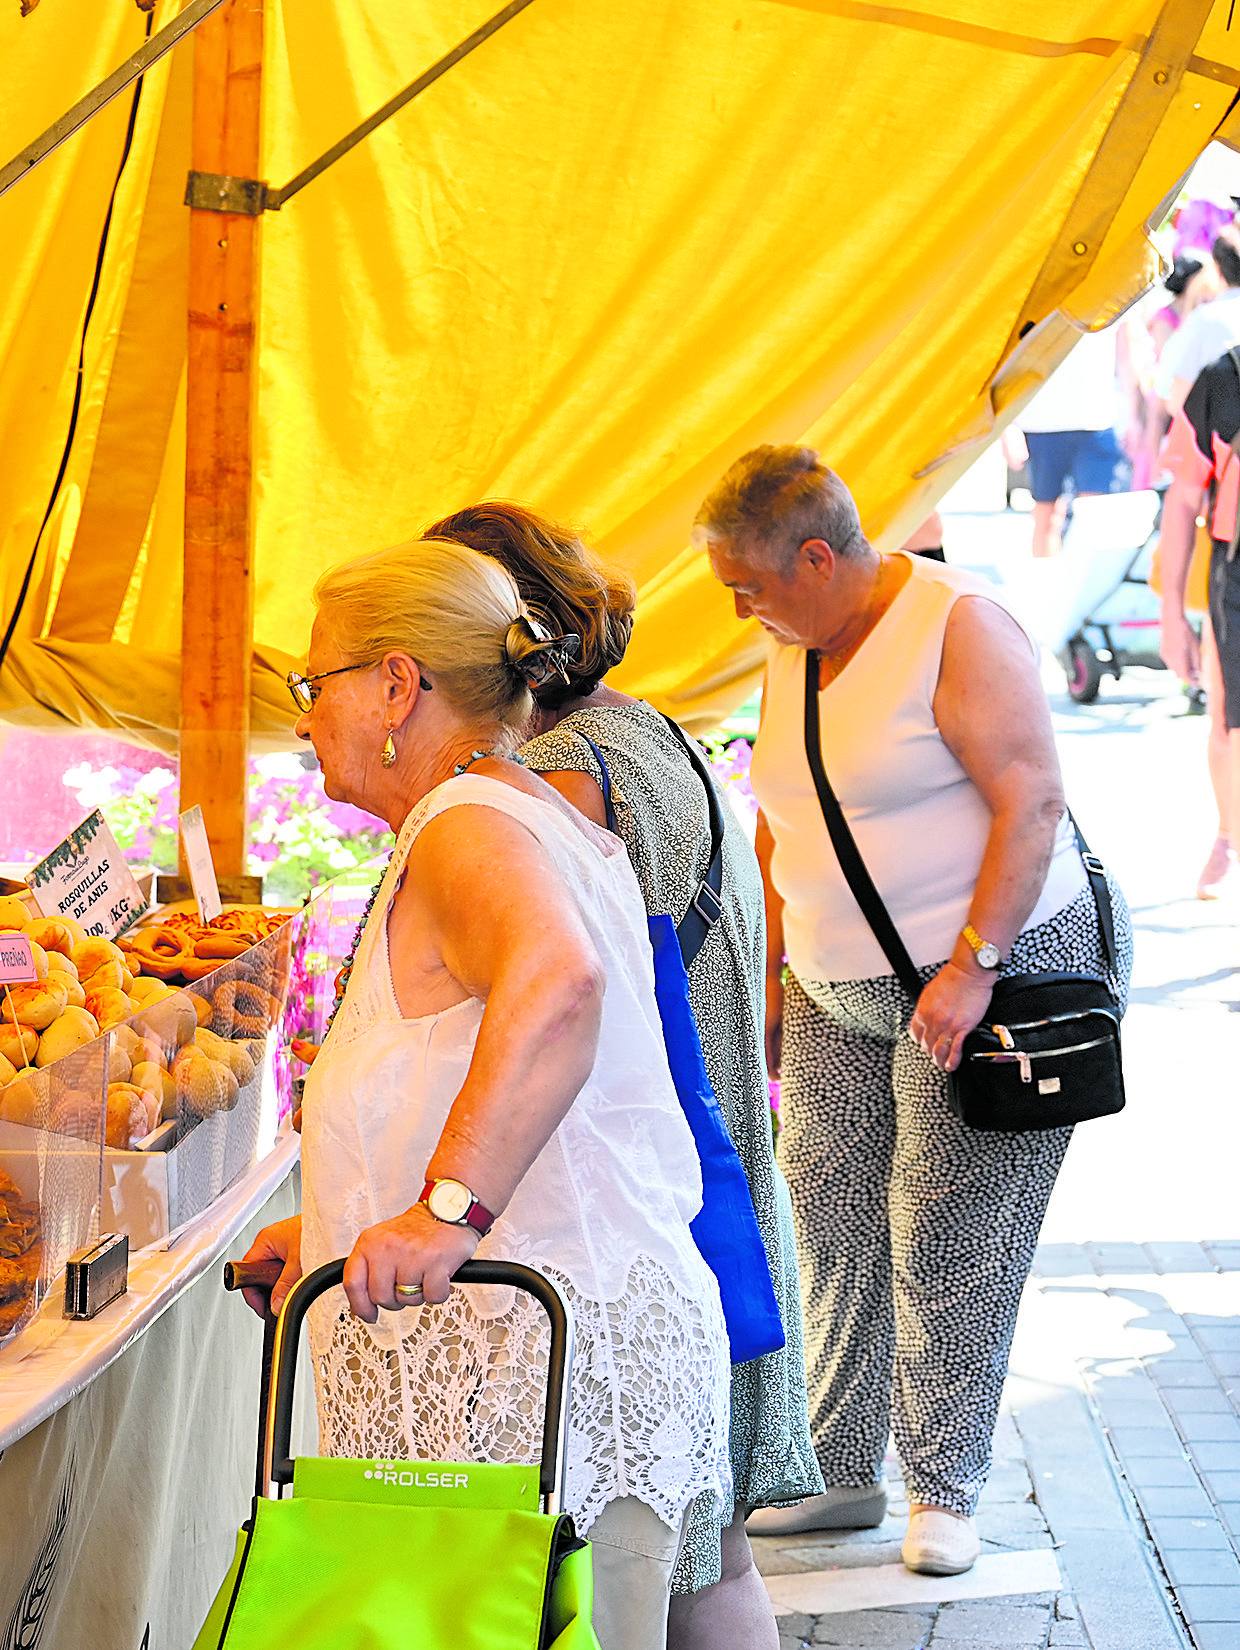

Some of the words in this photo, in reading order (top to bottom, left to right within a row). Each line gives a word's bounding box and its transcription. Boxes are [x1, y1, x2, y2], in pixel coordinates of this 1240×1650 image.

[57, 858, 110, 914] ROSQUILLAS
[73, 901, 88, 919] DE
[88, 880, 109, 907] ANIS
[0, 946, 28, 968] PREÑAO
[384, 1471, 469, 1488] ROLSER
